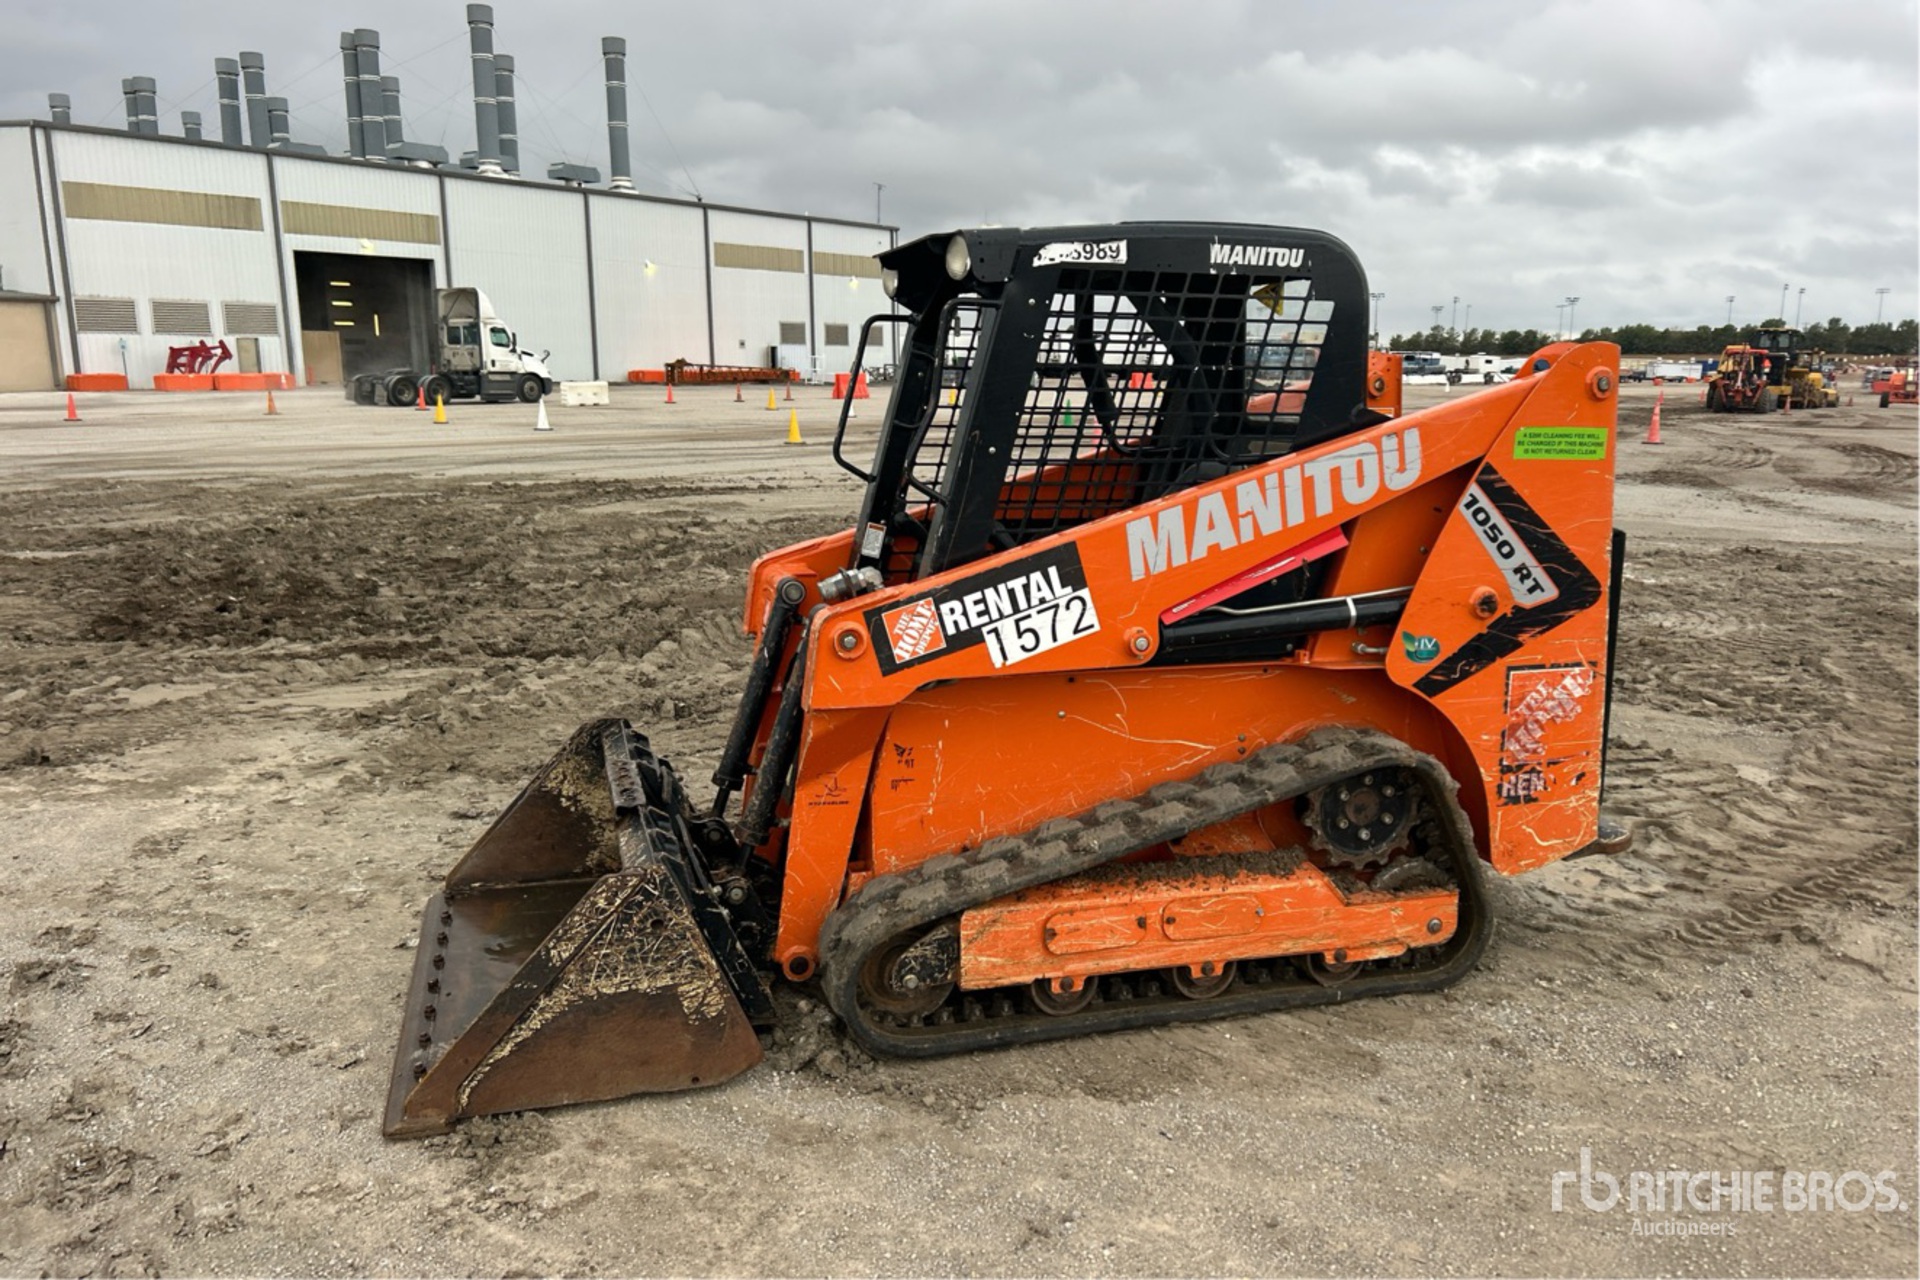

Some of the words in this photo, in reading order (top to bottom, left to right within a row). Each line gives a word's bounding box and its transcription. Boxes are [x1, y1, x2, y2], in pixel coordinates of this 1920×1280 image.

[1210, 244, 1305, 268] MANITOU
[1578, 440, 1604, 448] MACHINE
[1126, 427, 1422, 582] MANITOU
[1463, 492, 1516, 560] 1050
[1512, 562, 1546, 596] RT
[893, 611, 911, 636] THE
[893, 600, 936, 661] HOME
[939, 565, 1073, 636] RENTAL
[986, 595, 1095, 662] 1572
[915, 617, 940, 656] DEPOT
